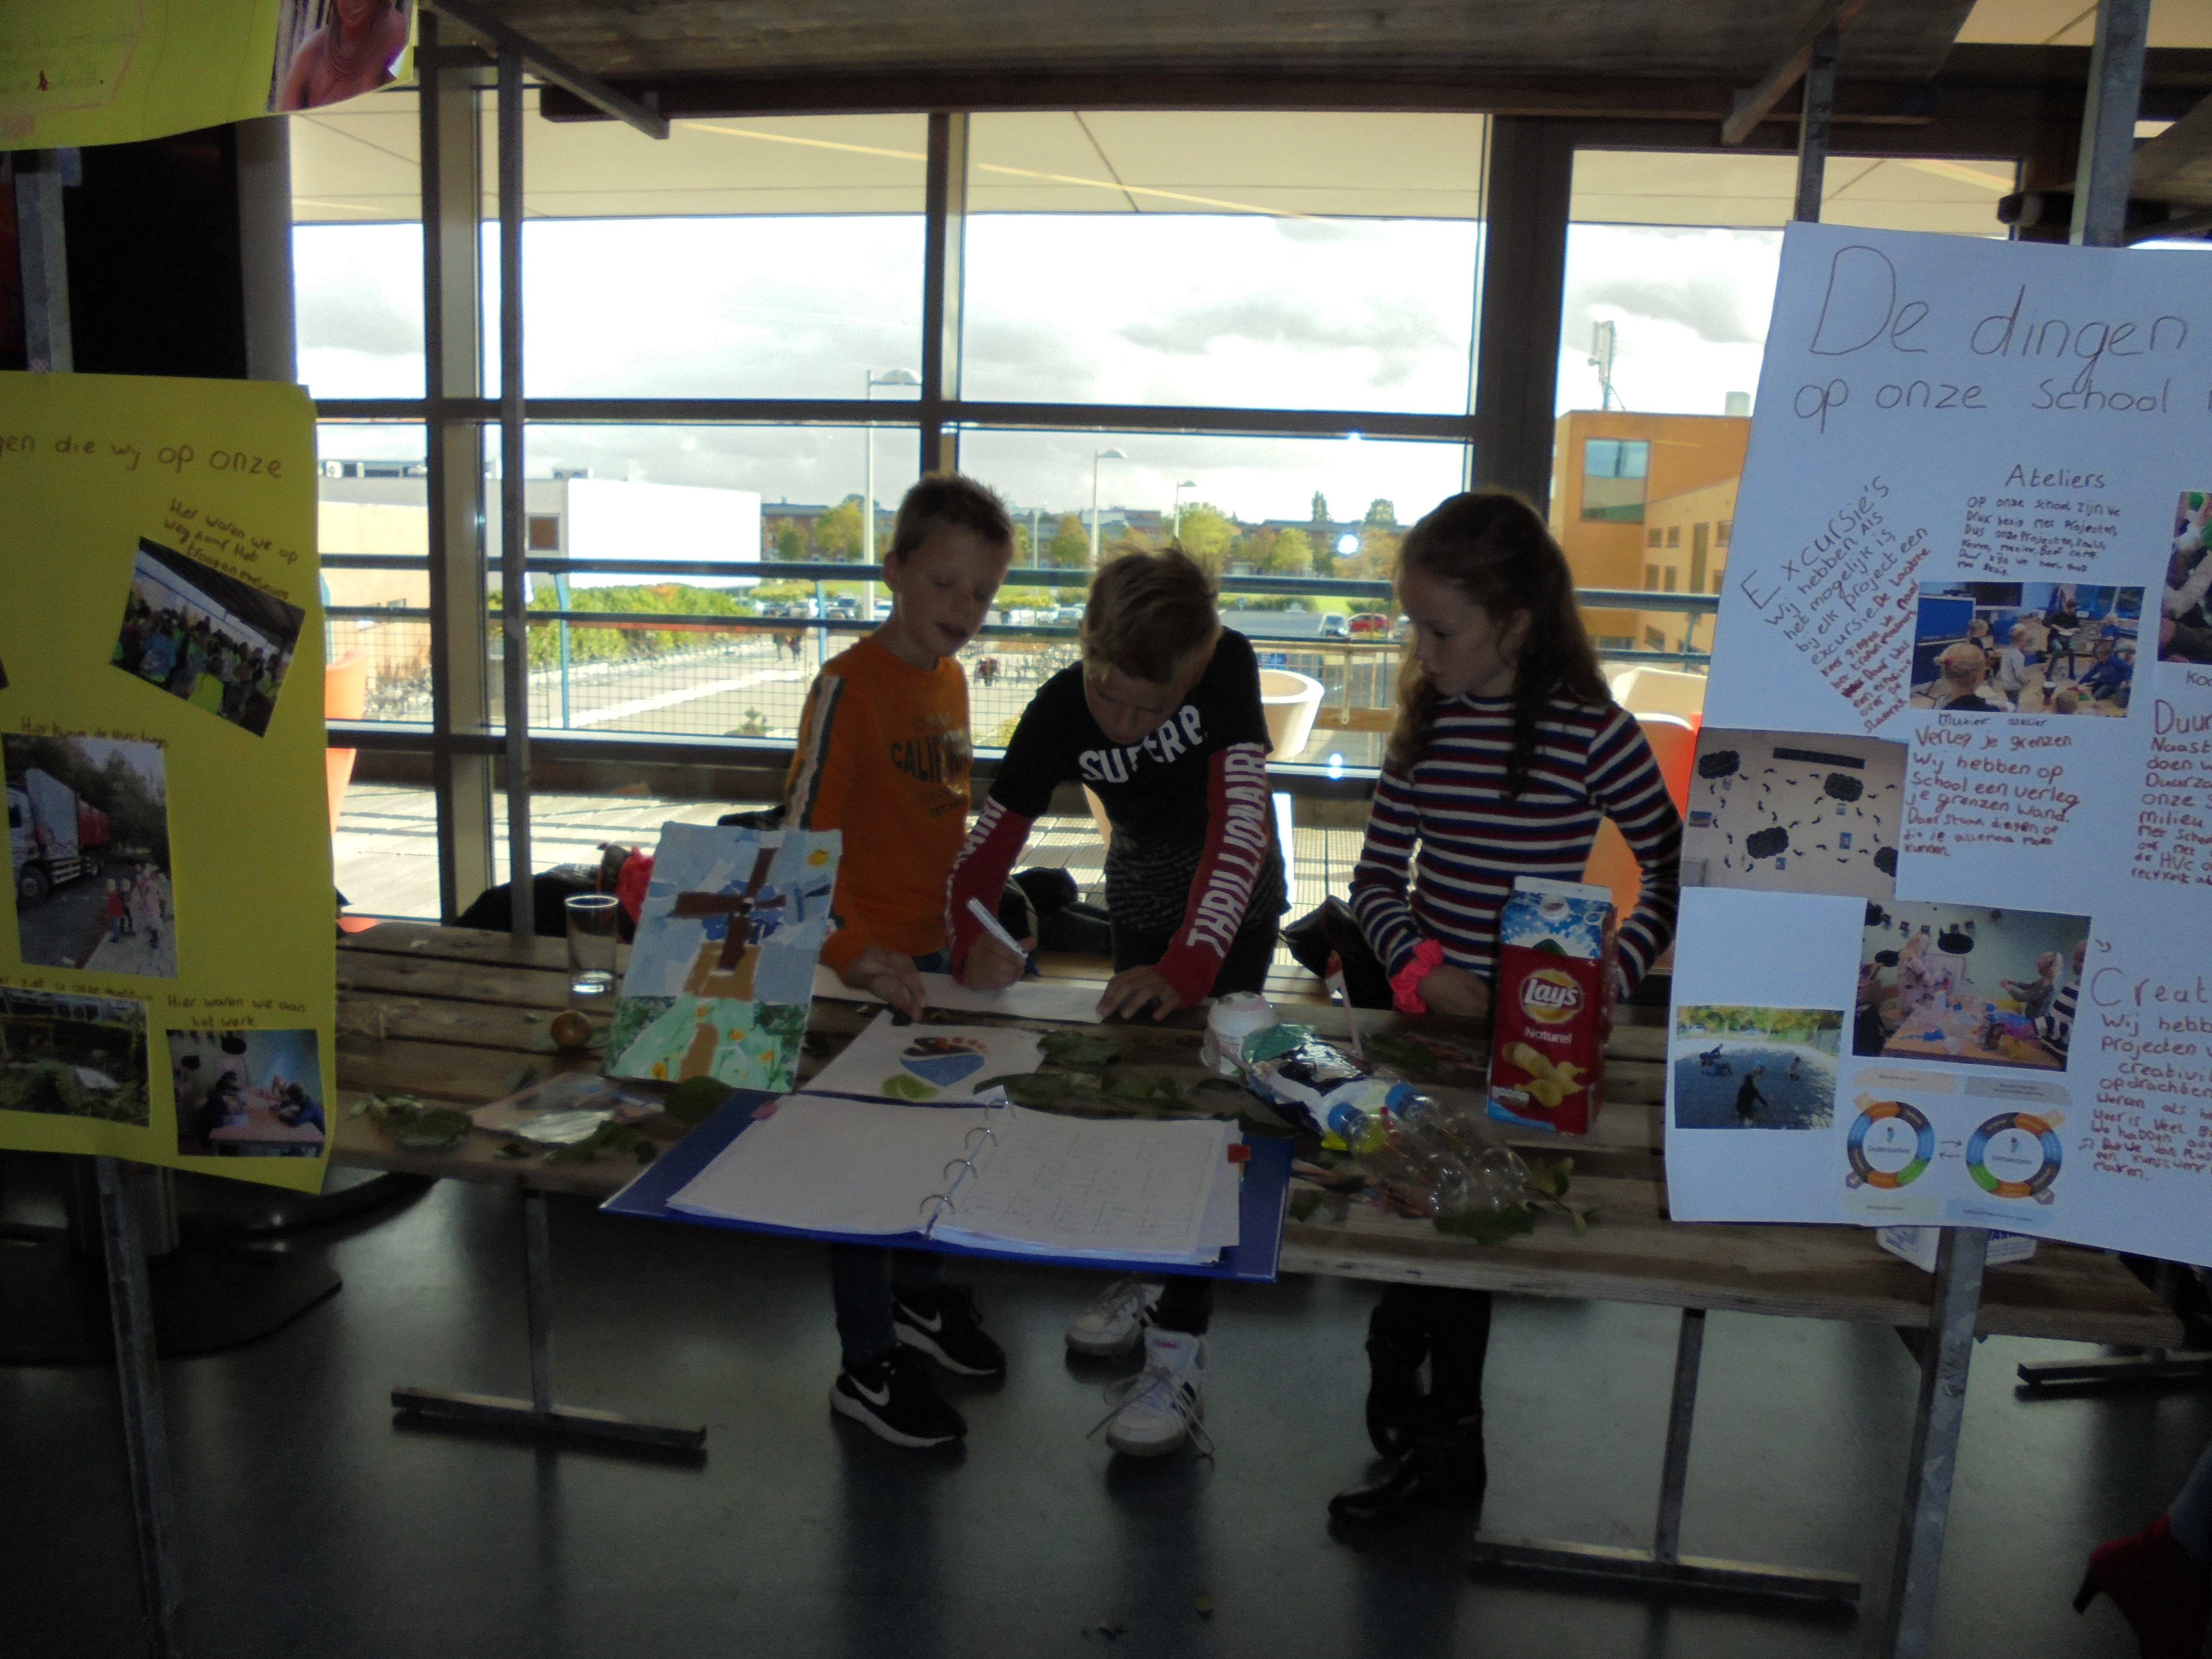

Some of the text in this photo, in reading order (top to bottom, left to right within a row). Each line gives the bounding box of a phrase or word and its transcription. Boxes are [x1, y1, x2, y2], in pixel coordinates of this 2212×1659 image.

[1809, 245, 2188, 395] De dingen
[1794, 378, 1849, 434] op
[1875, 380, 1988, 410] onze
[55, 434, 95, 453] die
[158, 444, 195, 474] op
[209, 449, 283, 479] onze
[2005, 463, 2105, 489] Ateliers
[1817, 609, 1840, 635] elk
[1900, 528, 1928, 553] een
[1784, 614, 1810, 640] het
[1957, 755, 2032, 775] hebben
[2037, 765, 2064, 785] op
[1975, 782, 2009, 796] een
